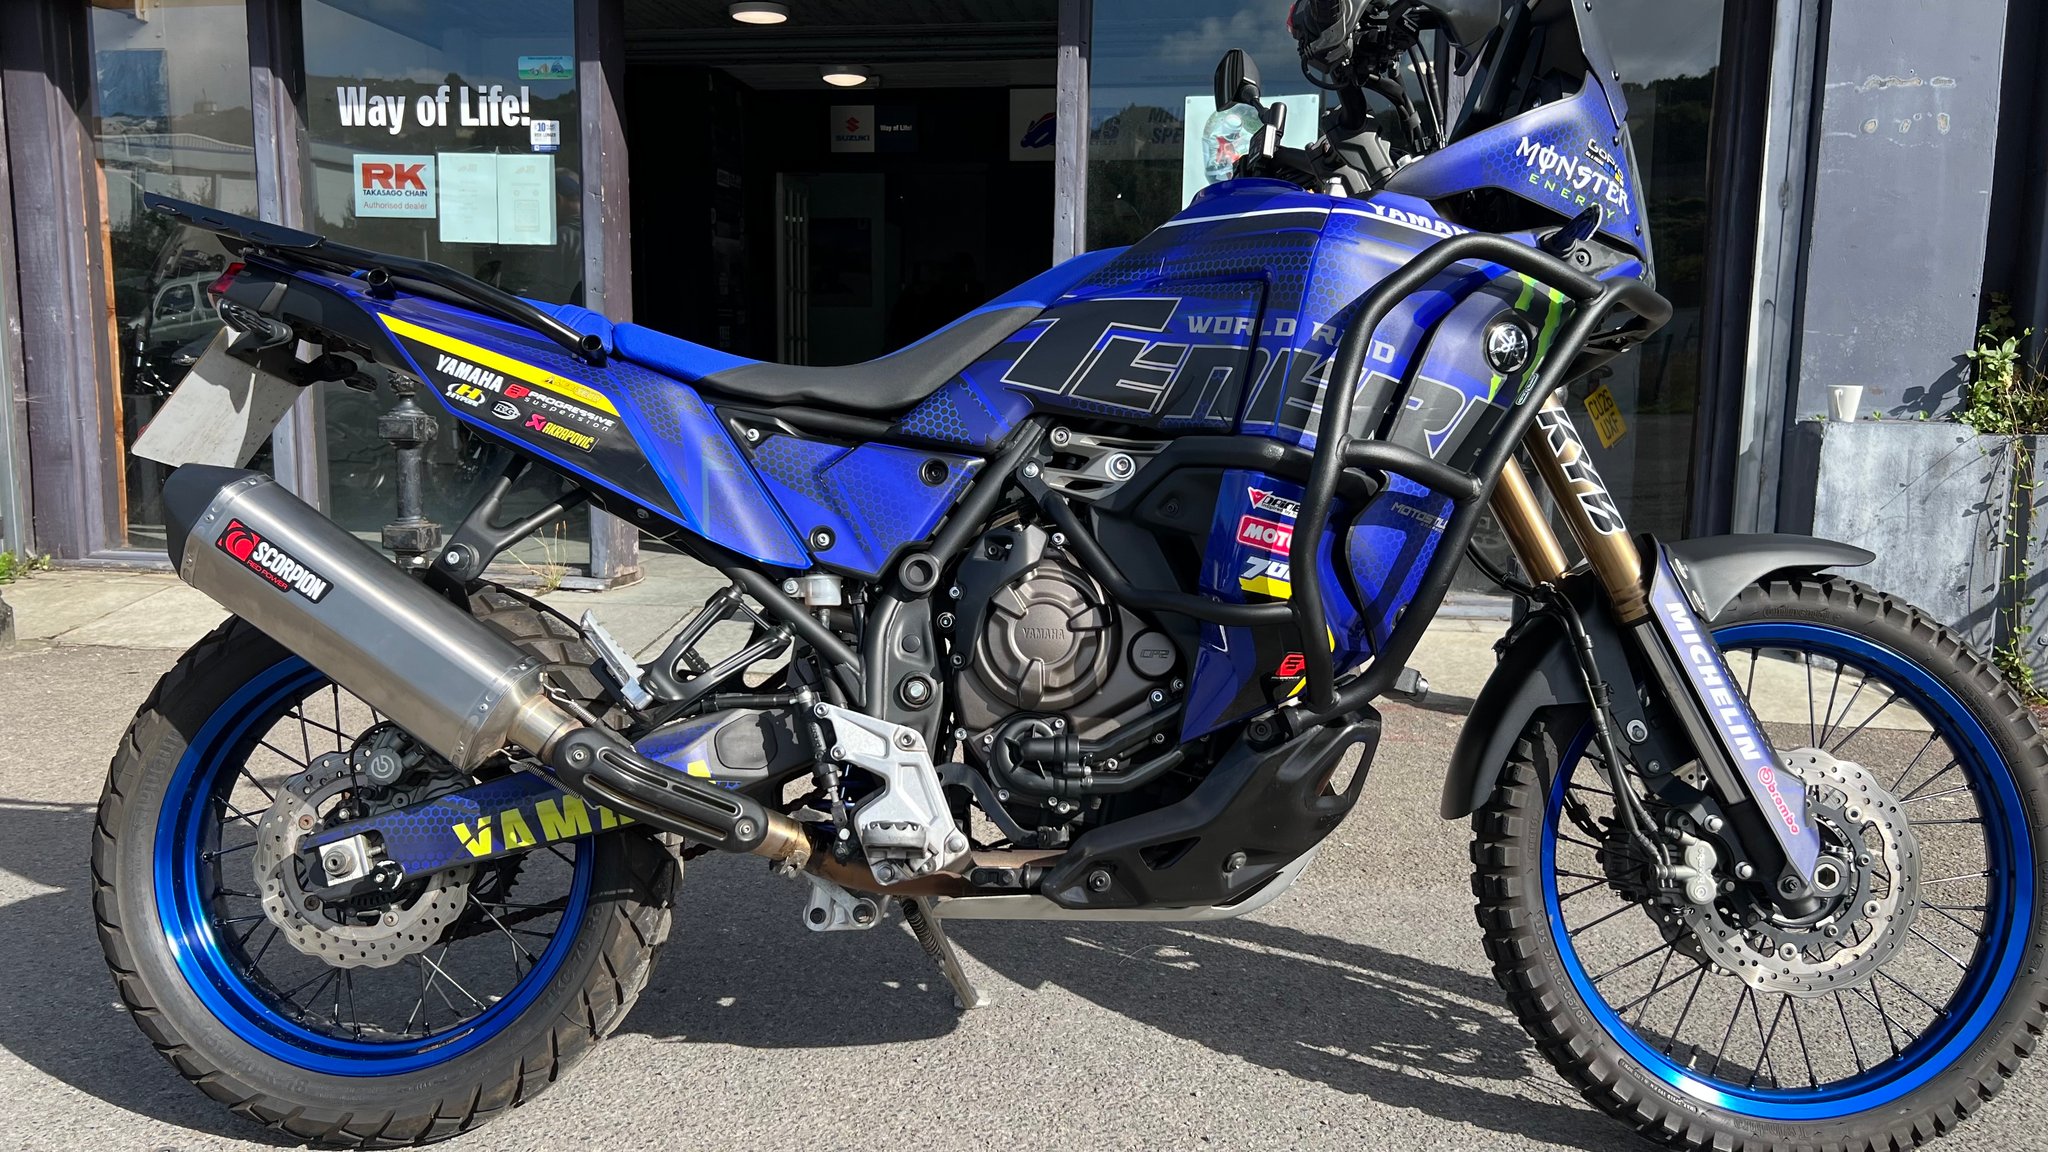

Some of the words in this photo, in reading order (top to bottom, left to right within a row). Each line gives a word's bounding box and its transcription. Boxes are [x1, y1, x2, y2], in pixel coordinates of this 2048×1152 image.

[337, 86, 406, 135] Way
[416, 85, 450, 127] of
[460, 85, 531, 127] Life!
[362, 163, 427, 190] RK
[363, 201, 403, 209] Authorised
[405, 202, 427, 210] dealer
[1188, 315, 1296, 338] WORLD
[435, 354, 504, 393] YAMAHA
[524, 397, 609, 432] suspension
[527, 390, 616, 427] PROGRESSIVE
[1589, 388, 1614, 422] CU26
[1600, 413, 1619, 441] UXF
[247, 559, 262, 573] RED
[261, 568, 289, 590] POWER
[252, 541, 327, 601] SCORPION
[1022, 627, 1066, 641] YAMAHA
[1665, 601, 1761, 761] MICHELIN
[1766, 781, 1799, 835] brembo
